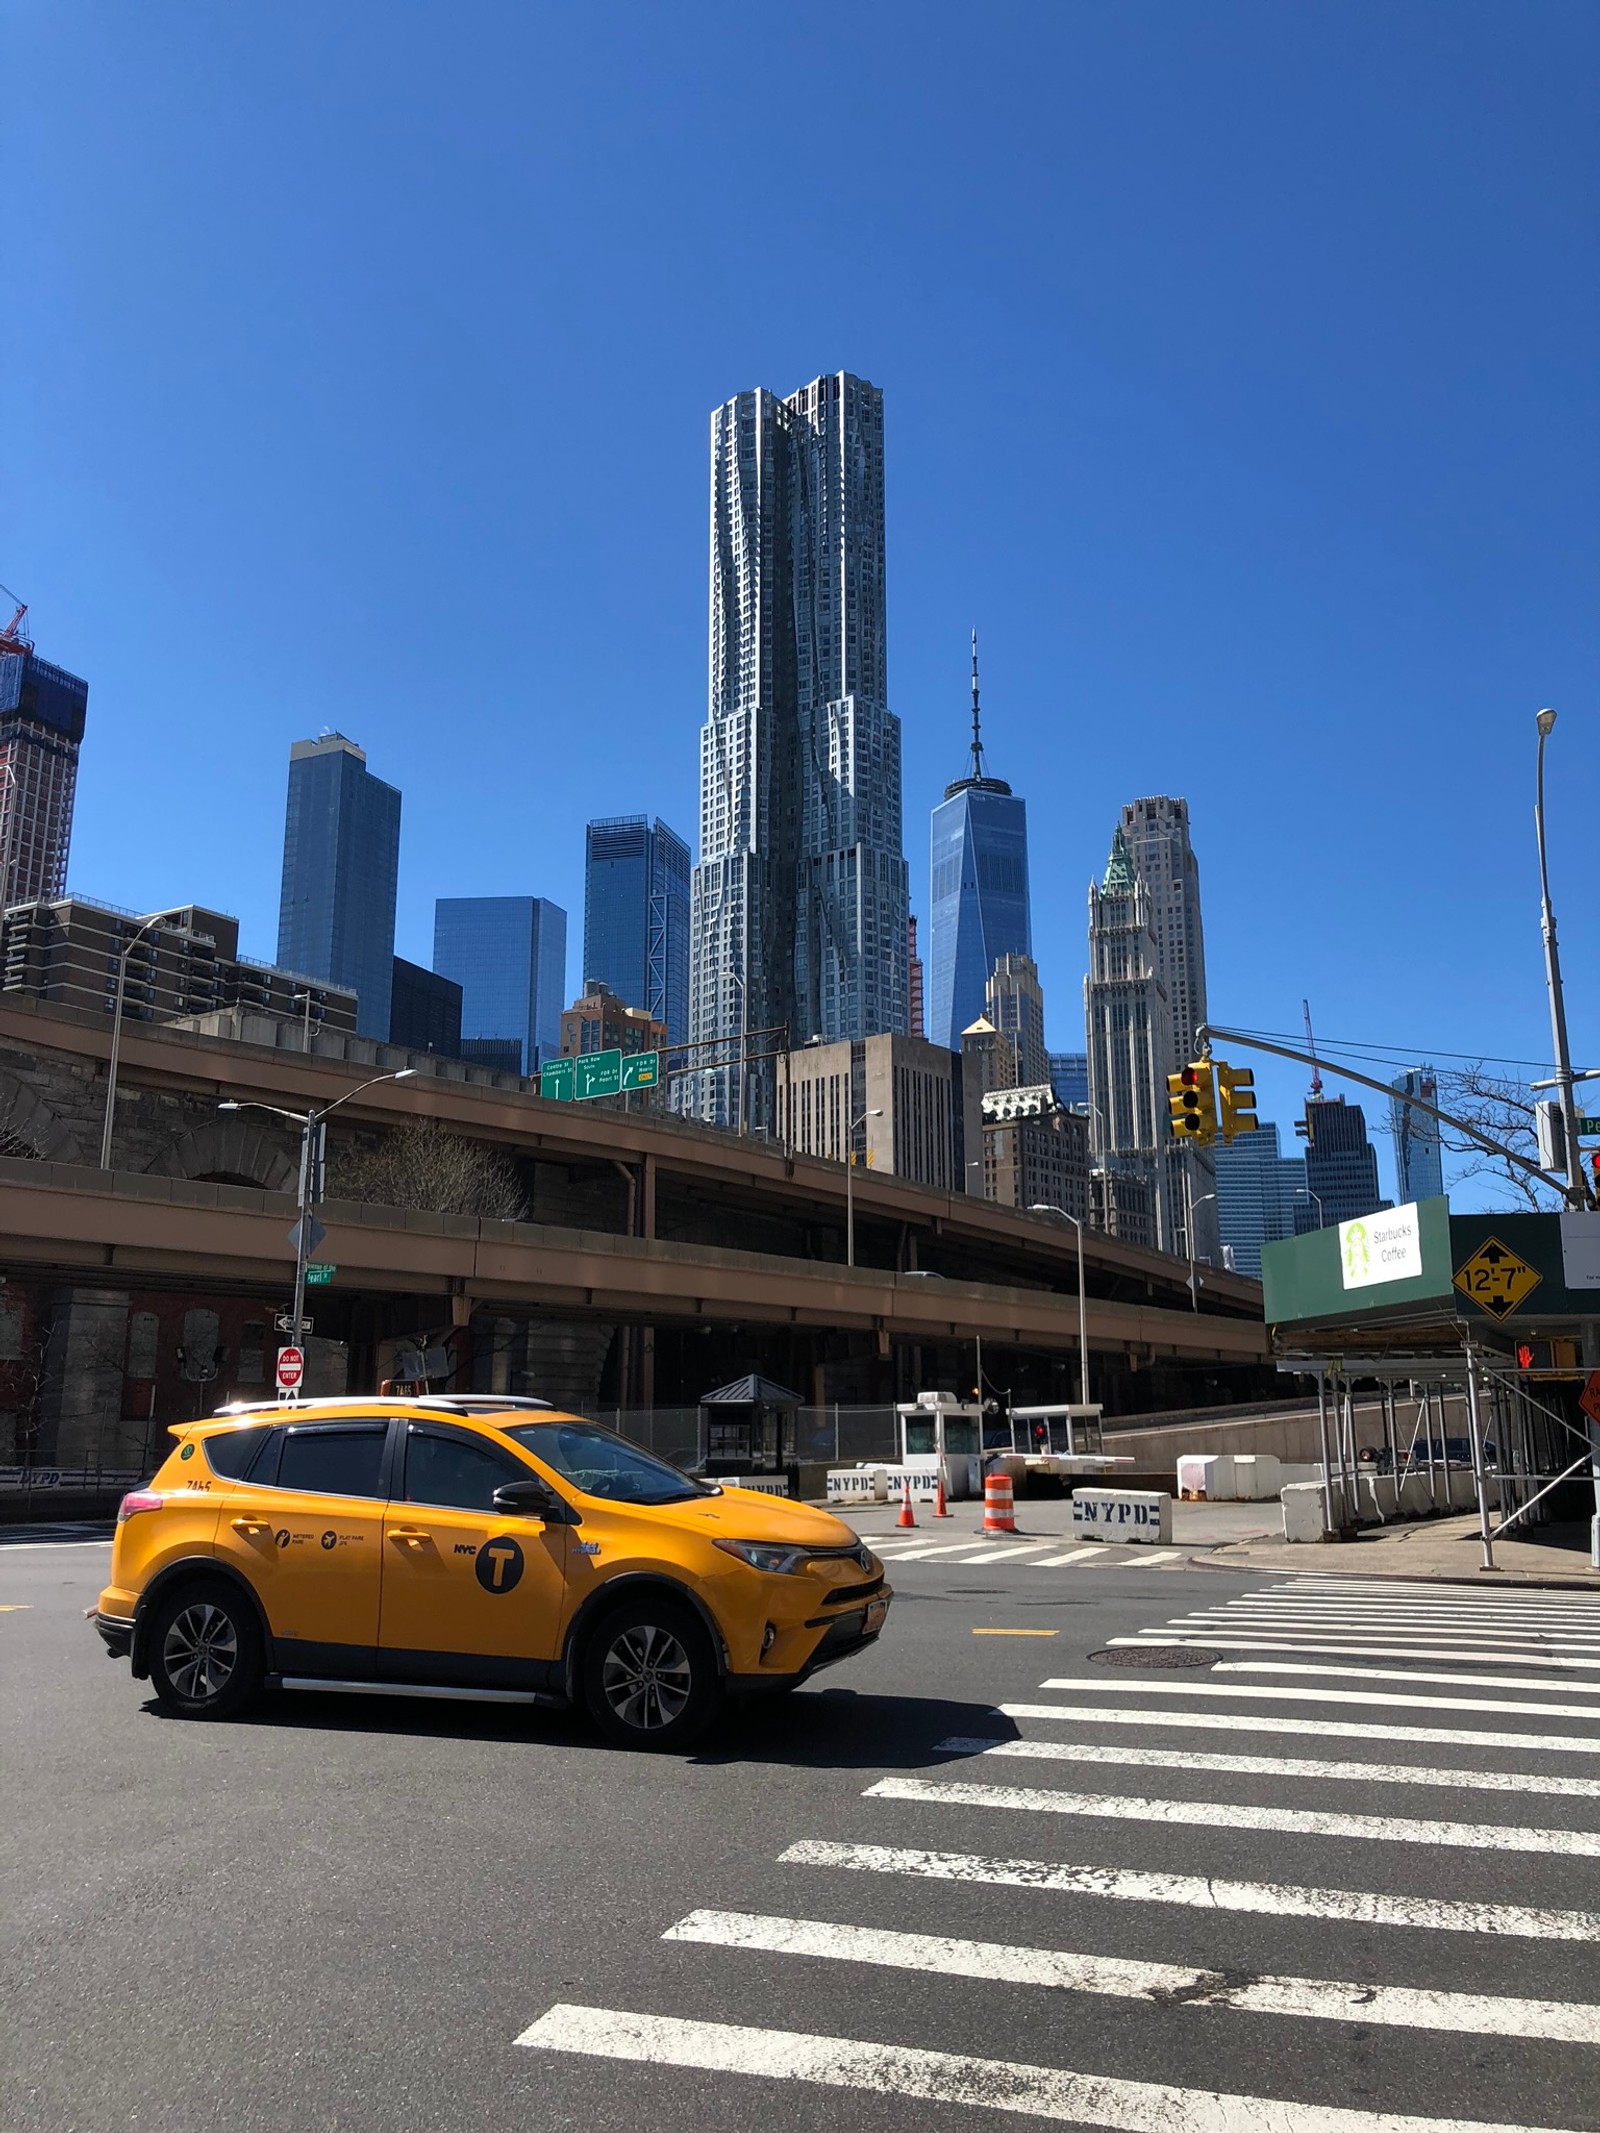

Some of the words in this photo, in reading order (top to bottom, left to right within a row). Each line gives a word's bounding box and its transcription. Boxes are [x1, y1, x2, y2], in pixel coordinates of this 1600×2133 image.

[1373, 1224, 1412, 1244] Starbucks
[1381, 1246, 1407, 1263] Coffee
[1464, 1266, 1526, 1291] 12'-7"
[833, 1476, 868, 1490] NYPD
[893, 1475, 930, 1490] NYPD
[1084, 1501, 1148, 1525] NYPD
[453, 1543, 477, 1555] NYC
[488, 1548, 514, 1587] T
